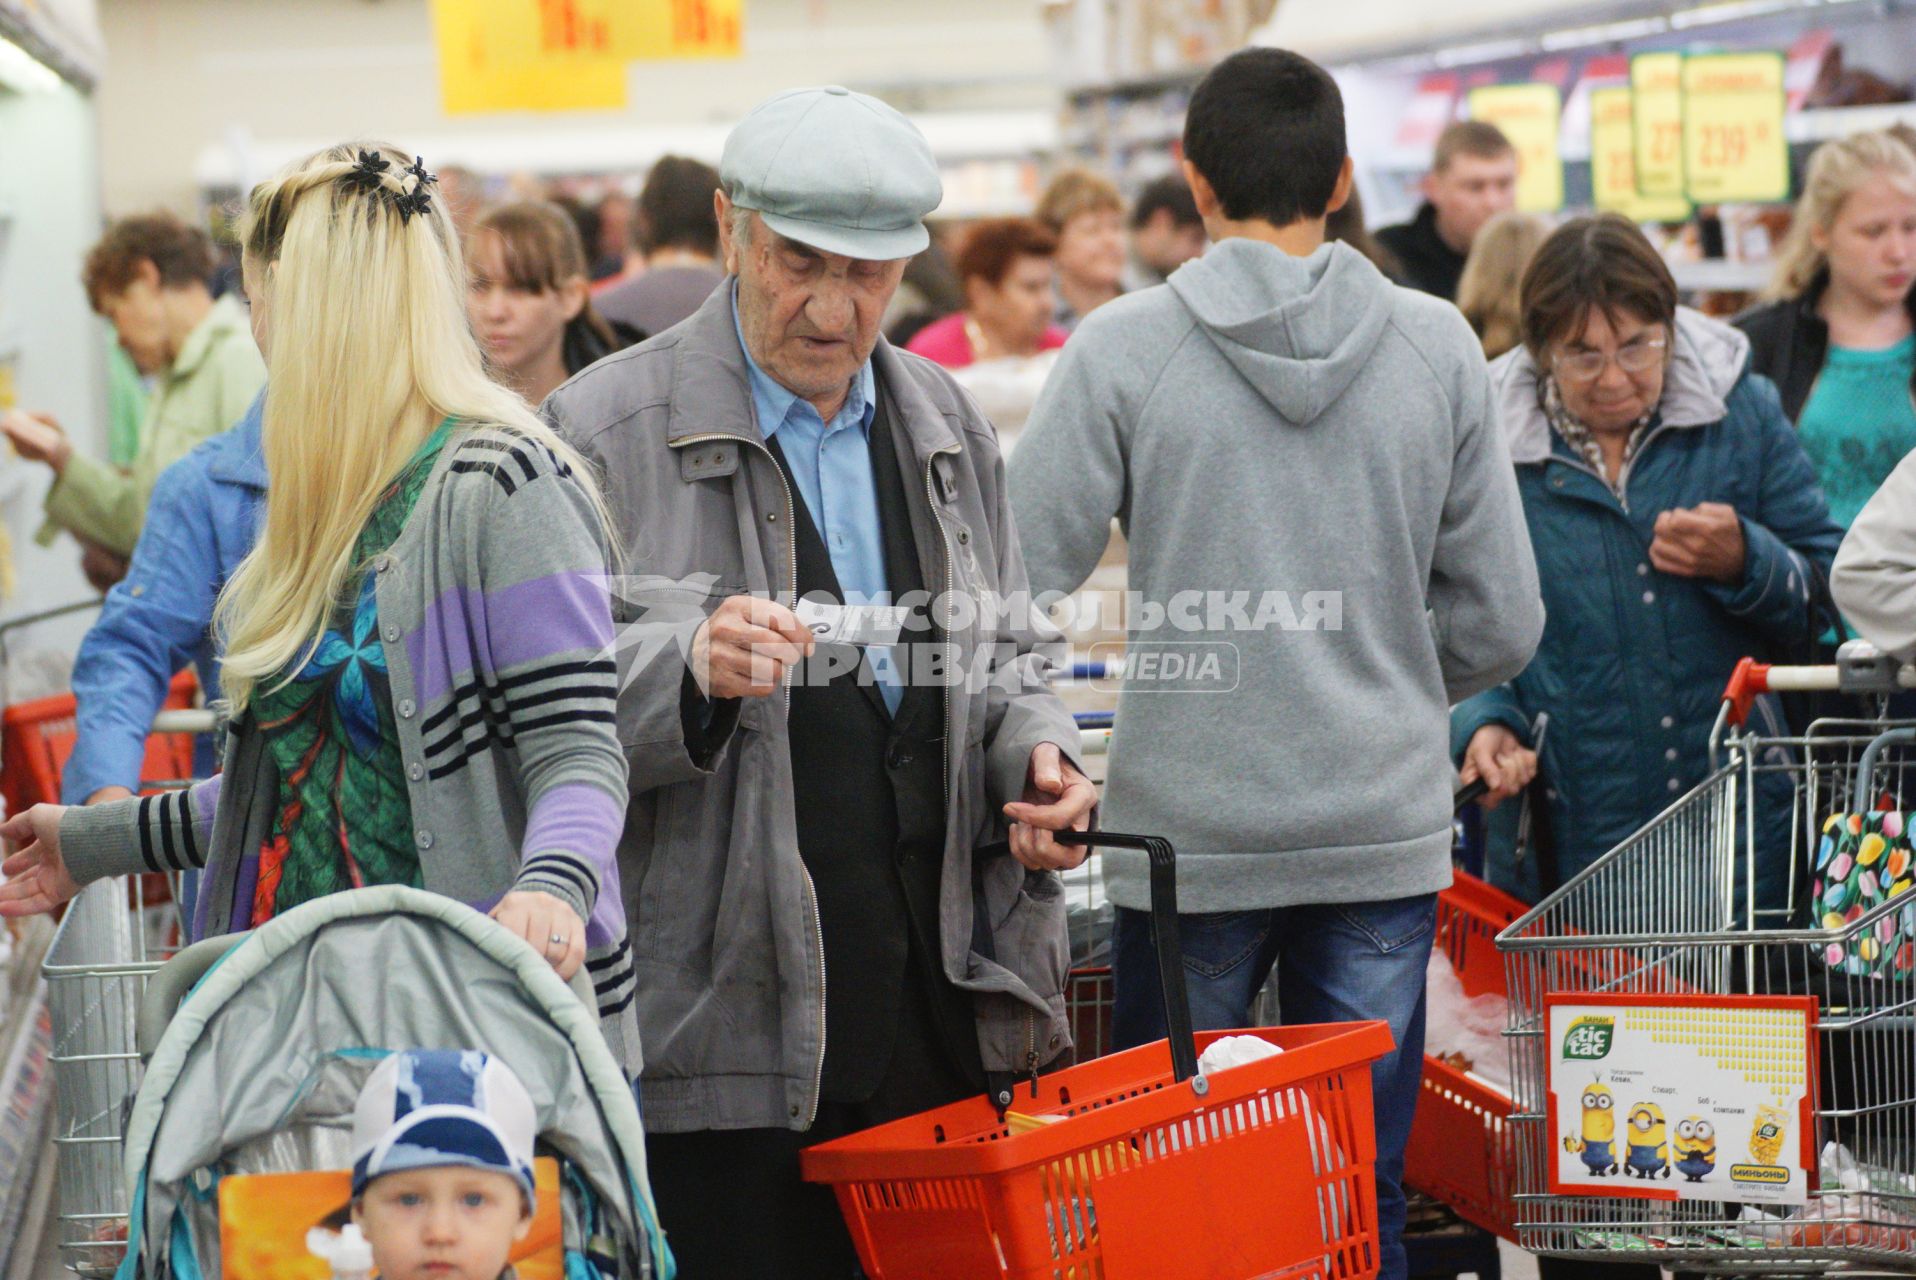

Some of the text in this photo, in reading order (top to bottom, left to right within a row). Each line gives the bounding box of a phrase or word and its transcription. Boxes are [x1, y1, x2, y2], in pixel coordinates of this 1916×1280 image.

[1579, 1026, 1606, 1043] tic
[1570, 1041, 1605, 1056] tac
[1733, 1169, 1786, 1180] МИНЬОНЫ
